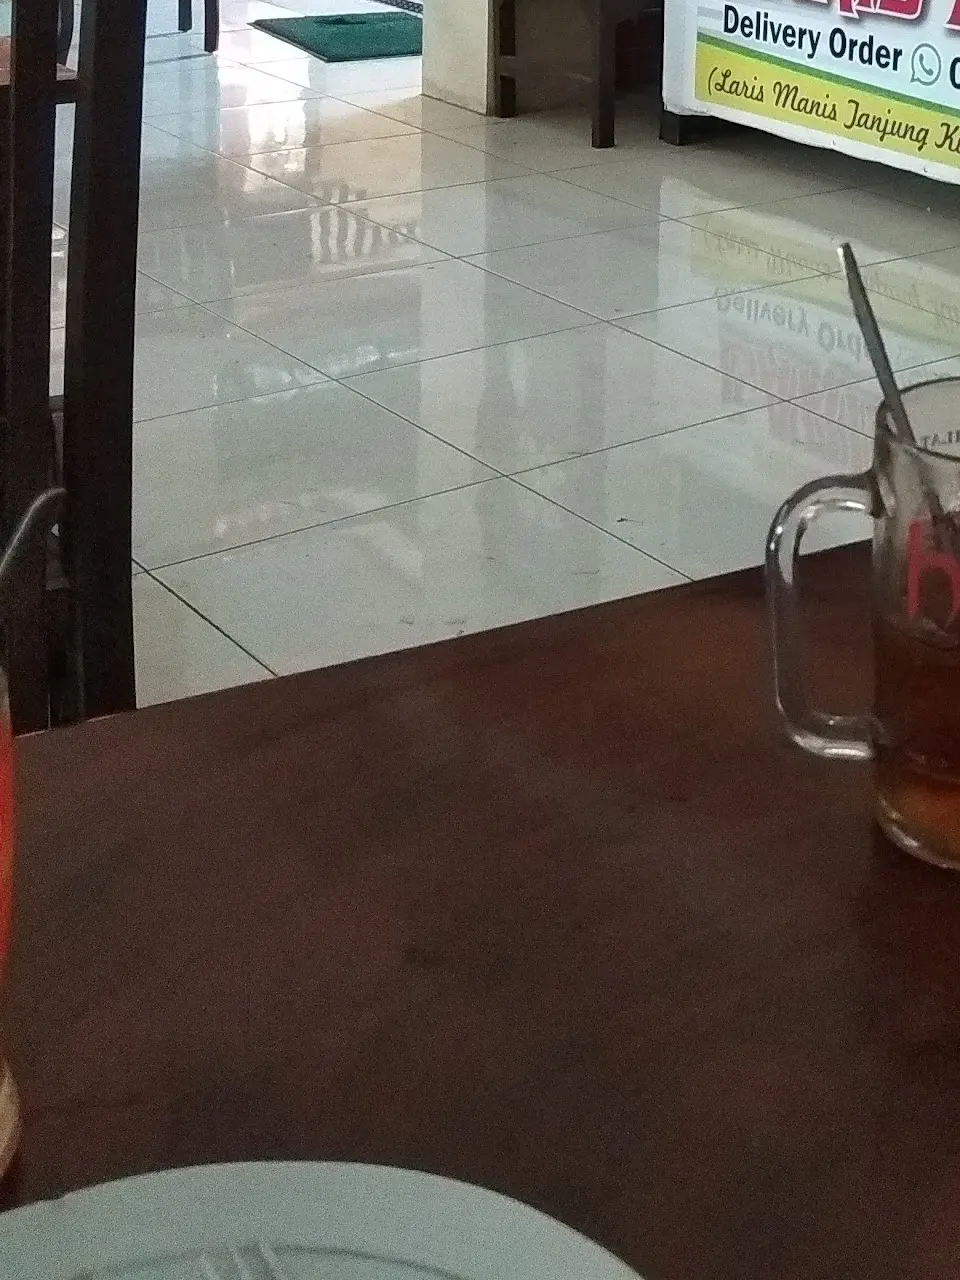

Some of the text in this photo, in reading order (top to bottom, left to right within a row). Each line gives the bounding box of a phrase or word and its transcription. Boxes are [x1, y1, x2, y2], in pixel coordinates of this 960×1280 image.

[723, 4, 821, 59] Delivery
[829, 27, 903, 71] Order
[708, 67, 764, 103] (Laris
[773, 81, 837, 121] Manis
